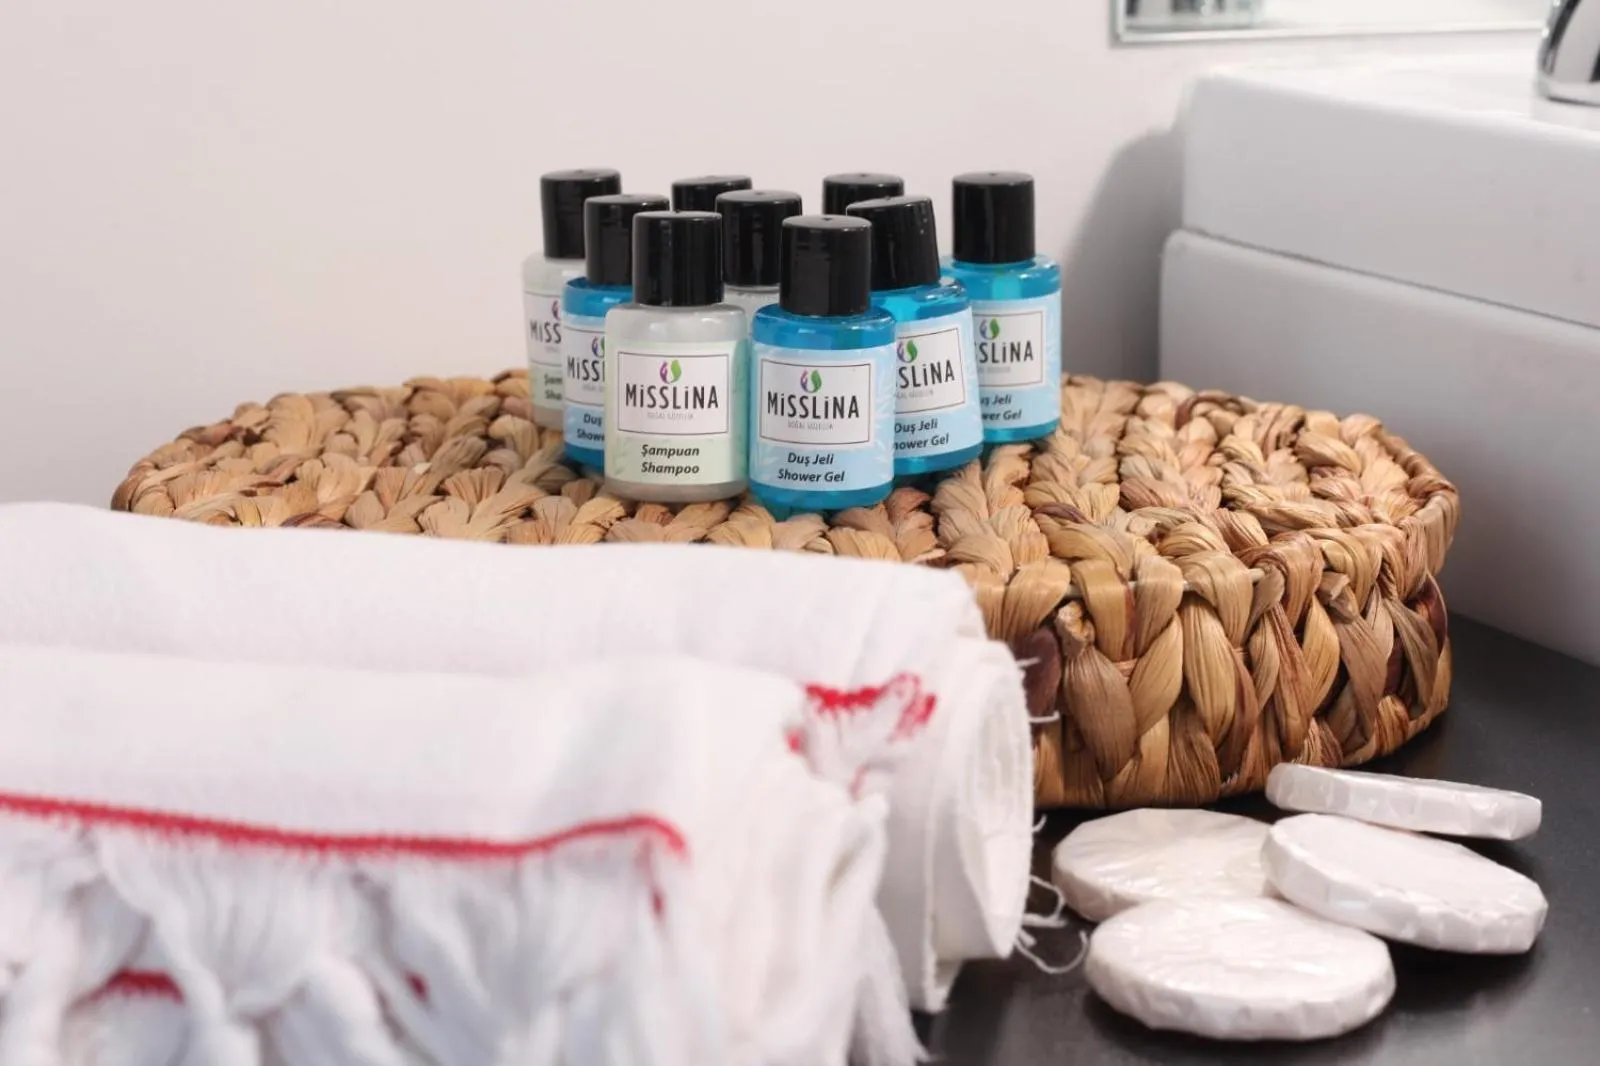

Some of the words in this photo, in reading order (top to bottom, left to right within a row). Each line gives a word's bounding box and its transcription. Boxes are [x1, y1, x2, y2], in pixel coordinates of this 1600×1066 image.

[529, 321, 562, 344] MiSS
[974, 340, 1034, 364] SLiNA
[567, 356, 605, 382] MiSS
[895, 359, 955, 389] SLiNA
[625, 383, 719, 410] MiSSLiNA
[767, 391, 859, 420] MiSSLiNA
[1003, 409, 1022, 420] Gel
[894, 422, 916, 435] Duş
[917, 418, 938, 431] Jeli
[894, 439, 928, 450] ower
[930, 432, 949, 446] Gel
[641, 444, 700, 459] Şampuan
[787, 452, 810, 467] Duş
[812, 453, 834, 465] Jeli
[641, 461, 700, 476] Shampoo
[778, 468, 821, 483] Shower
[824, 471, 845, 482] Gel
